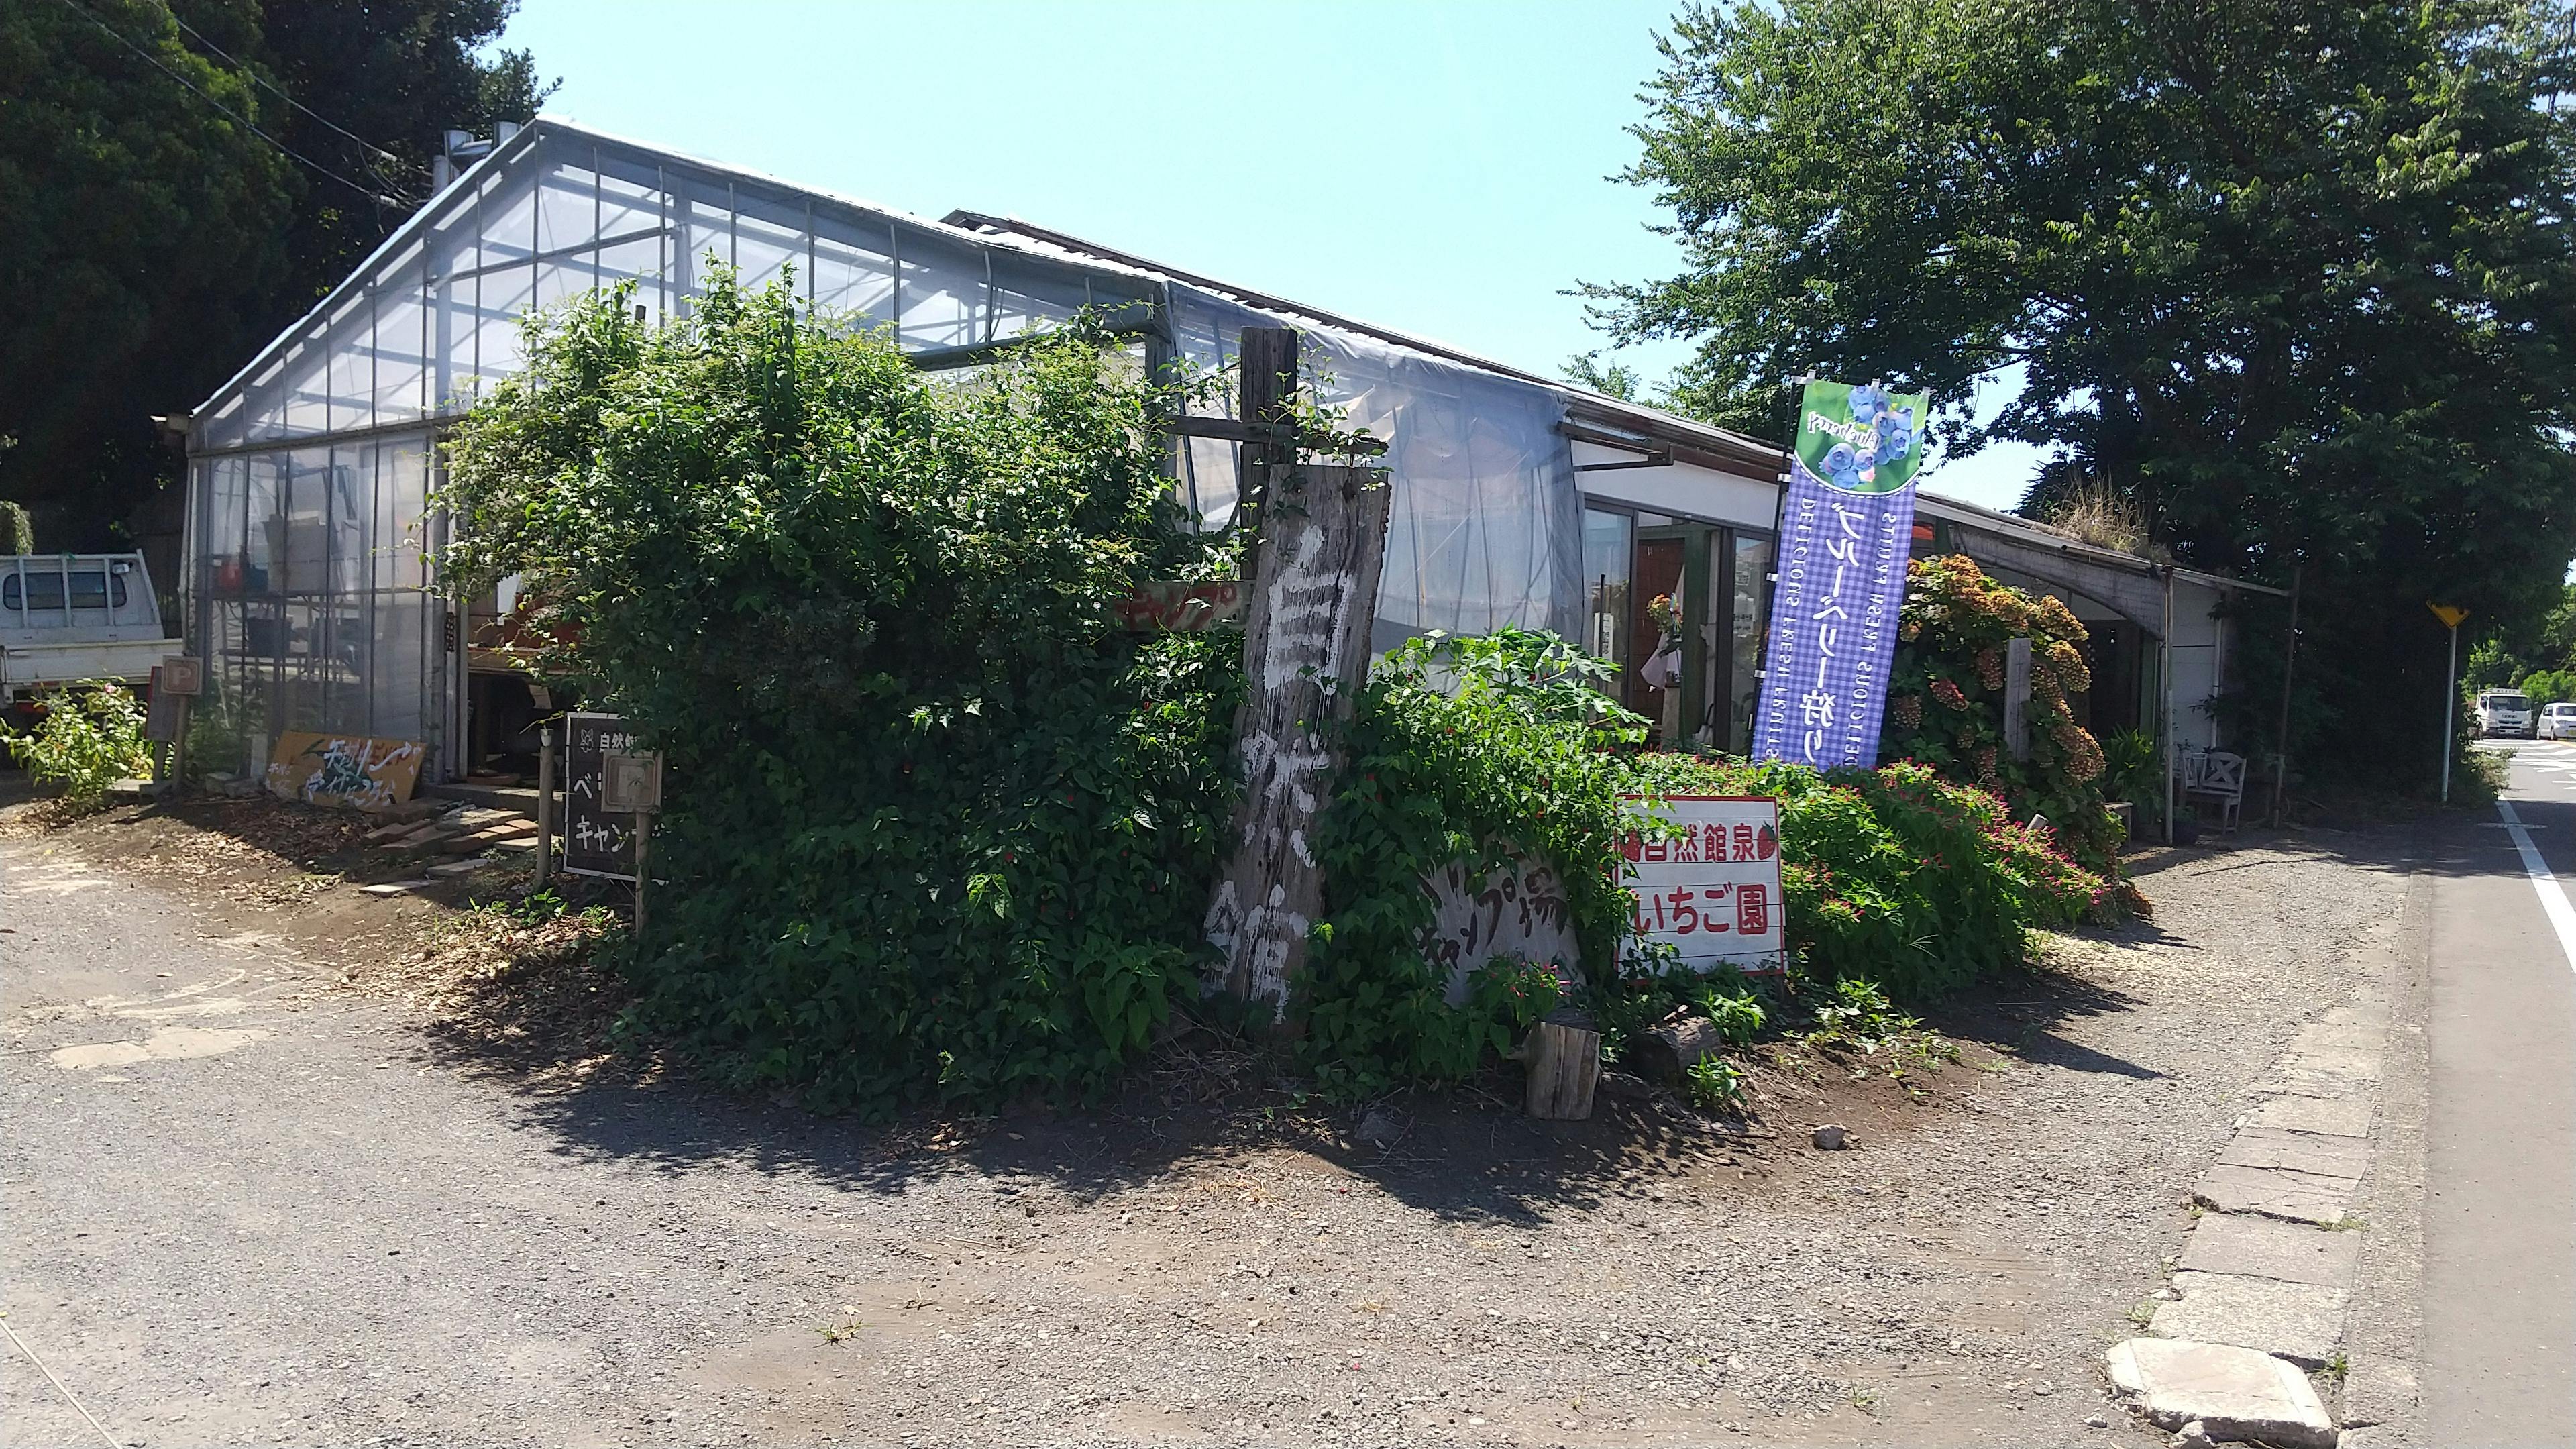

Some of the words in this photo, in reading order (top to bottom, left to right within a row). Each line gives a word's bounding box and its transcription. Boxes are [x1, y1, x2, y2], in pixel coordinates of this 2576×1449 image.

[576, 814, 637, 853] キャン
[1633, 880, 1768, 937] いちご園
